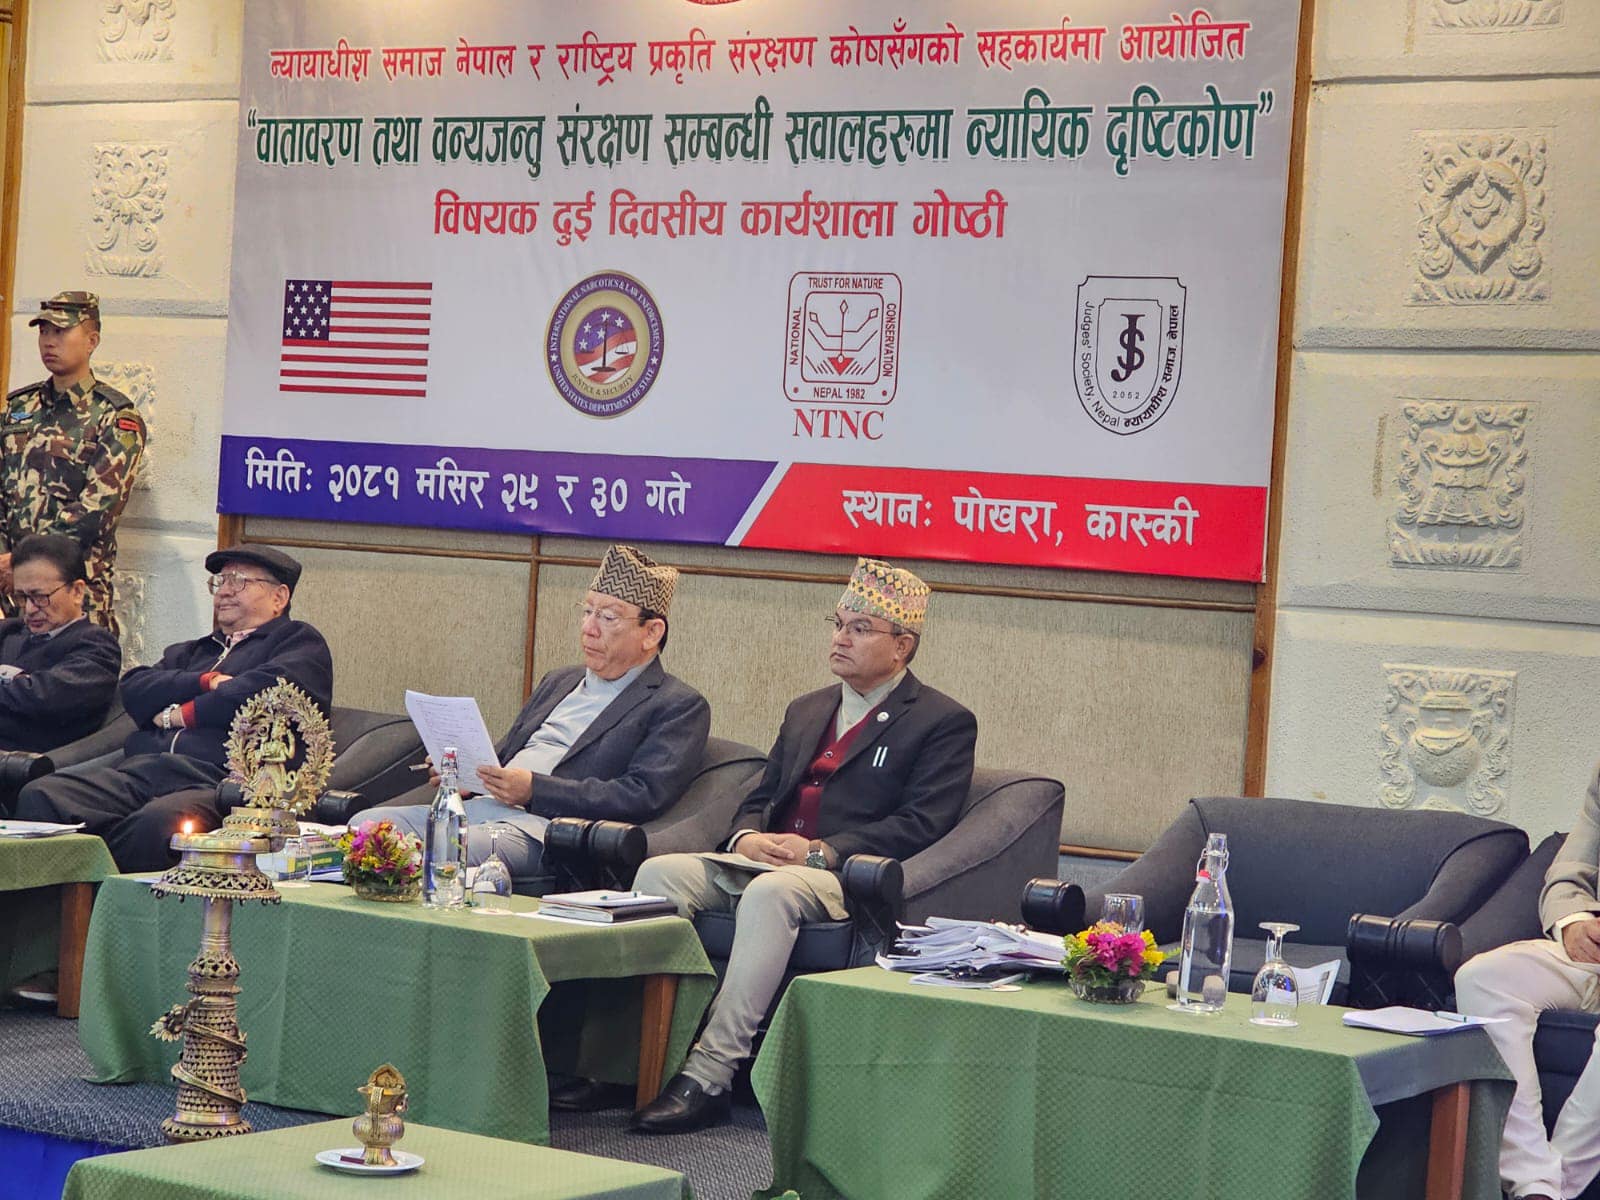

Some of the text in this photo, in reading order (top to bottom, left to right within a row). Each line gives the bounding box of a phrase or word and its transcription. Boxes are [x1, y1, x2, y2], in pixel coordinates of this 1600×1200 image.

[271, 11, 1249, 85] न्यायाधीश समाज नेपाल र राष्ट्रिय प्रकृति संरक्षण कोषसँगको सहकार्यमा आयोजित
[374, 118, 422, 165] तथा
[433, 116, 545, 177] वन्यजन्तु
[557, 104, 652, 168] संरक्षण
[665, 96, 773, 165] सम्बन्धी
[786, 110, 953, 165] सवालहरूमा
[967, 88, 1092, 158] न्यायिक
[435, 190, 1007, 245] विषयक दुई दिवसीय कार्यशाला गोष्ठी
[808, 277, 884, 289] TRUST FOR NATURE
[550, 291, 582, 351] INTERNATIONAL
[580, 278, 619, 295] NARCOTICS
[625, 283, 640, 297] LAW
[637, 294, 660, 352] ENFORCEMENT
[790, 307, 802, 366] NATIONAL
[882, 302, 897, 377] CONSERVATION
[553, 364, 655, 412] UNITED STATES DEPARTMENT OF STATE
[602, 375, 635, 396] SECURITY
[813, 387, 843, 399] NEPAL
[1081, 352, 1095, 401] Society,
[1092, 400, 1121, 428] Nepal
[1124, 385, 1168, 427] न्यायाधीश
[1166, 304, 1179, 340] नेपाल
[792, 408, 884, 441] NTNC
[329, 465, 398, 502] २०८१
[416, 457, 490, 509] मंसिर
[501, 474, 538, 512] २९
[556, 475, 579, 514] र
[591, 477, 627, 517] ३०
[645, 471, 691, 516] गते
[953, 487, 1062, 545] पोखरा,
[1085, 497, 1199, 546] कास्की
